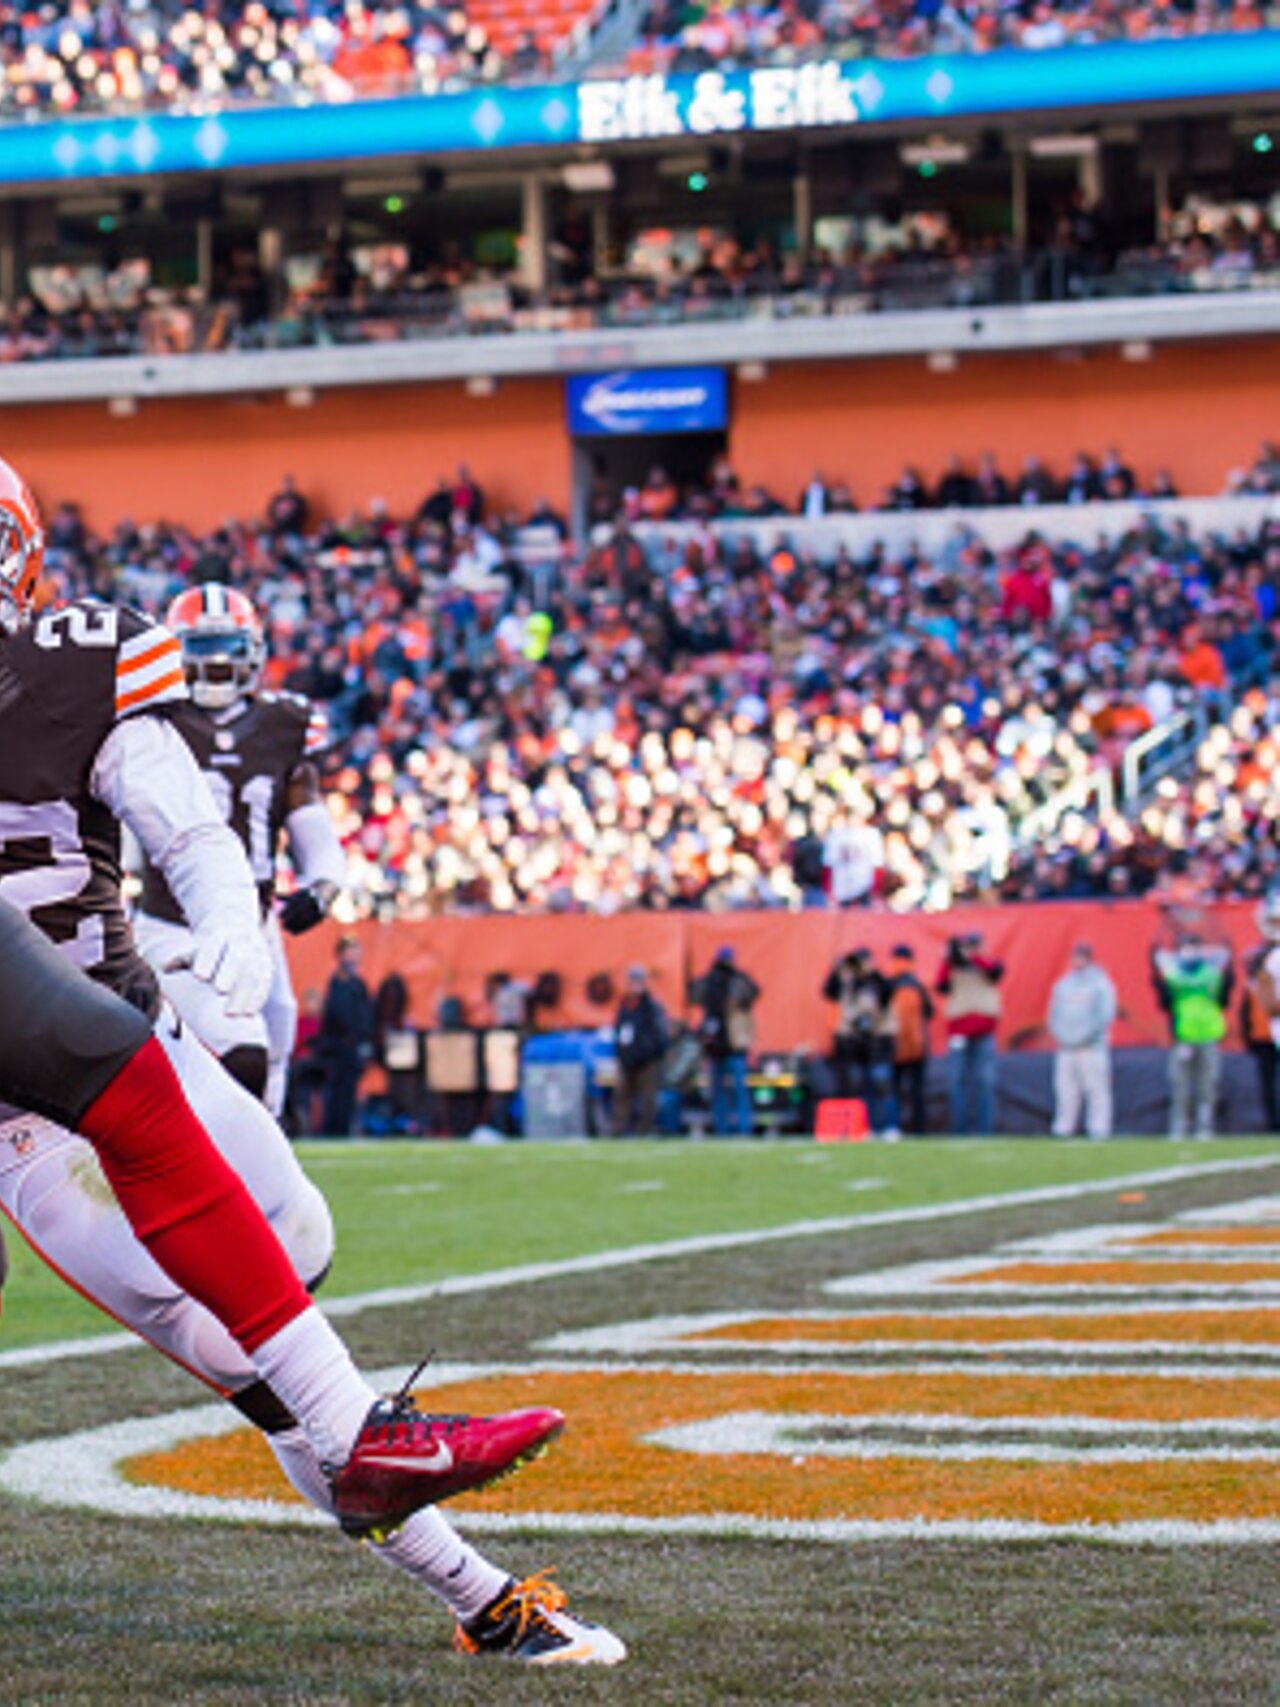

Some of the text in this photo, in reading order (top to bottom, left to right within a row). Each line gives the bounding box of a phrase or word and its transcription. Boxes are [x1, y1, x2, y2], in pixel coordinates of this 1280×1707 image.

[578, 61, 858, 141] Elk & Elk
